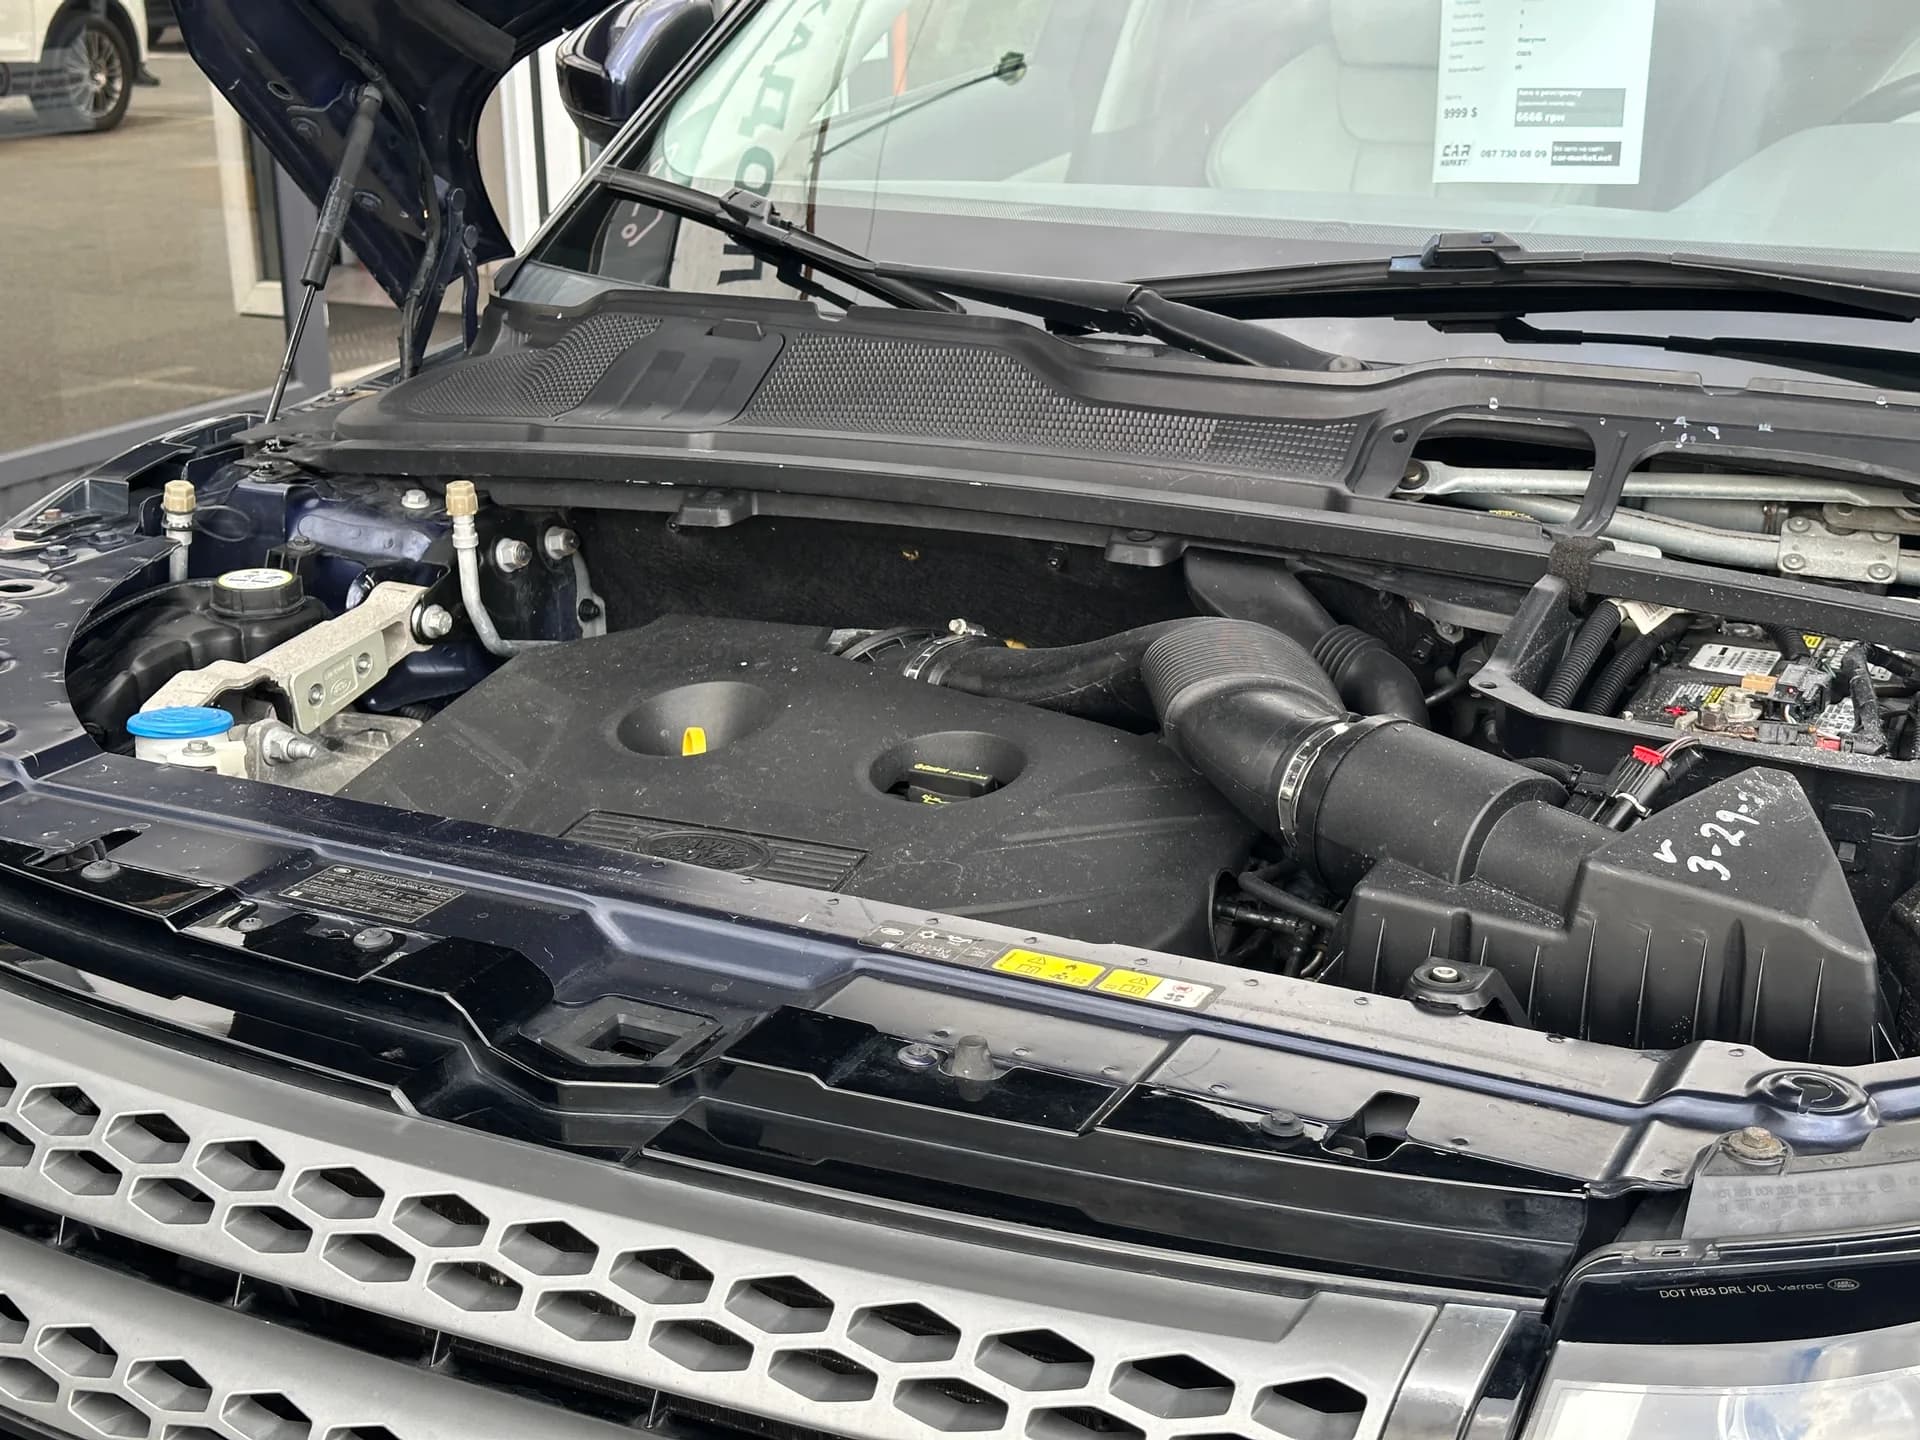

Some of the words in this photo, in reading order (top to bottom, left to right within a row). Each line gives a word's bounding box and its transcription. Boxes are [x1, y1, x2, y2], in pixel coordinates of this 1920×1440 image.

[1471, 107, 1478, 118] $
[1442, 144, 1471, 157] CAR
[1659, 1288, 1687, 1299] DOT
[1690, 1287, 1717, 1297] HB3
[1719, 1285, 1746, 1295] DRL
[1747, 1283, 1775, 1293] VOL
